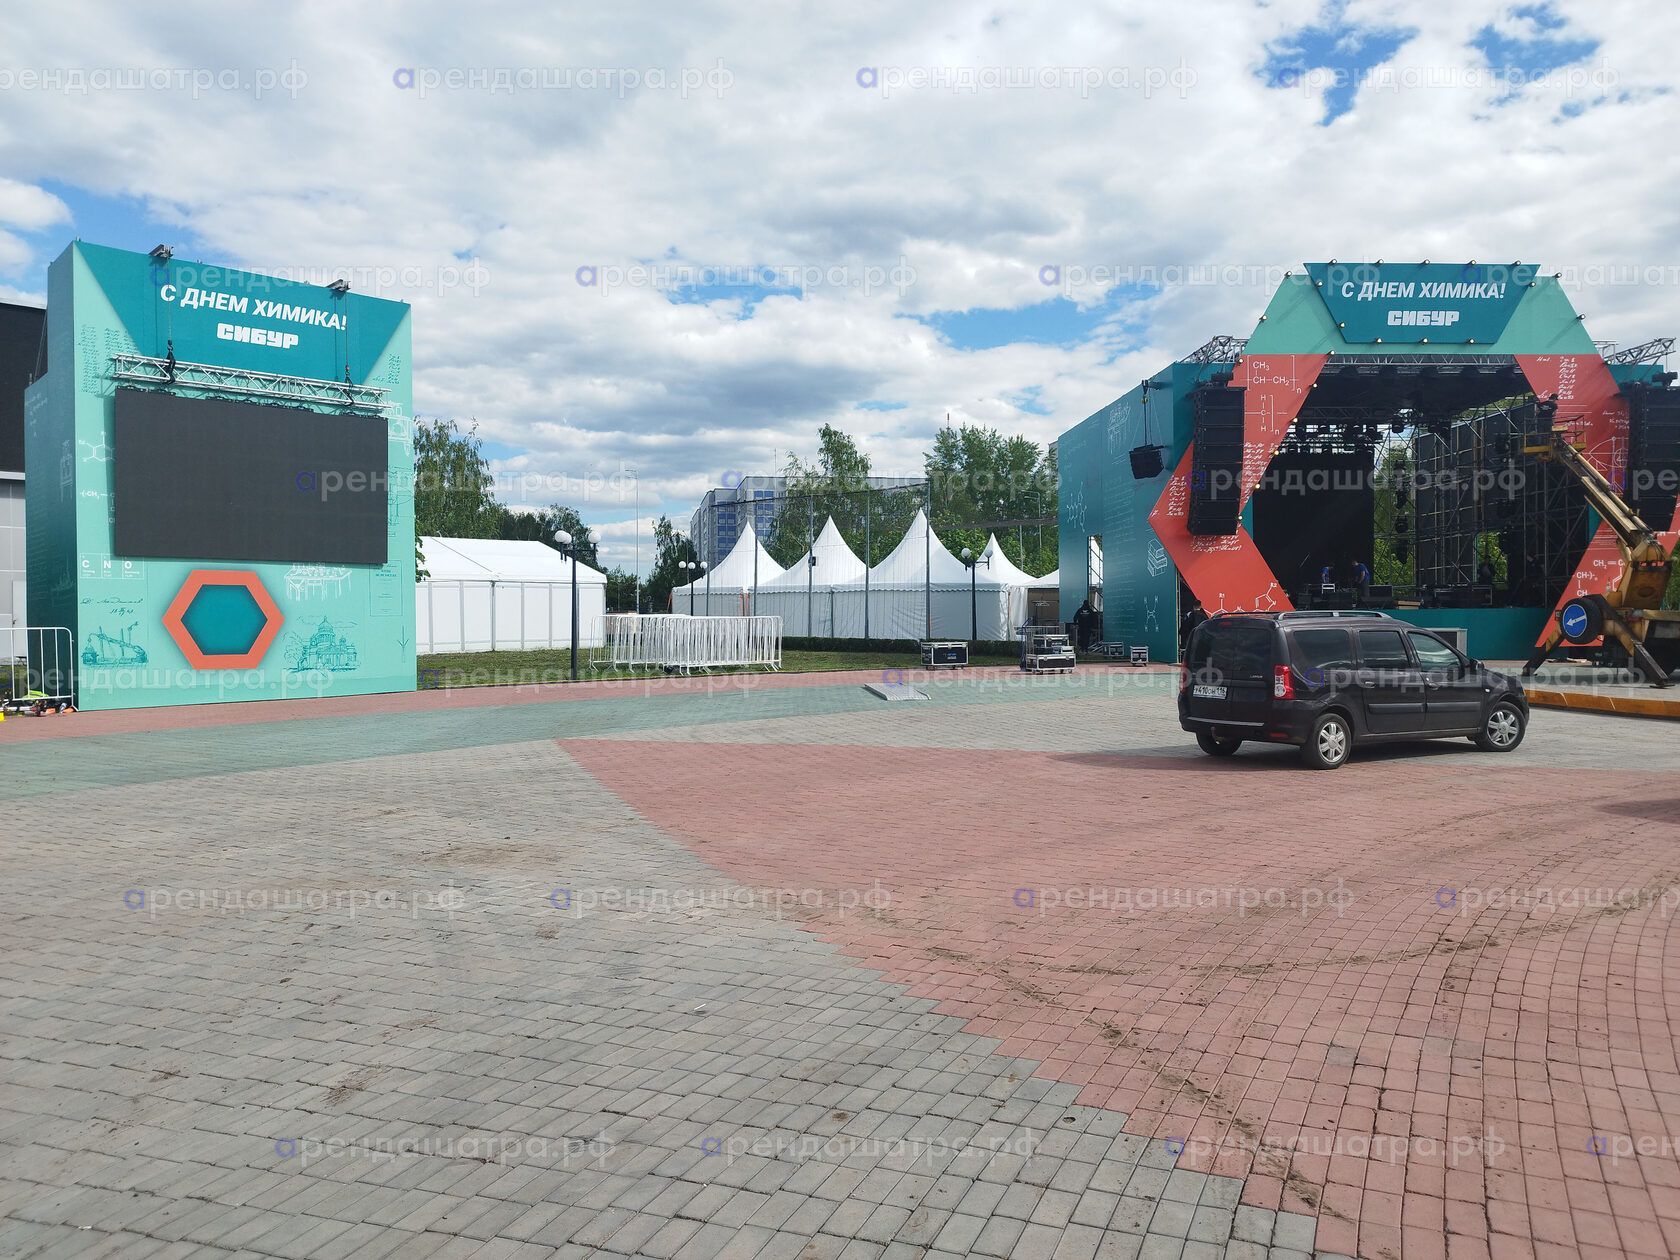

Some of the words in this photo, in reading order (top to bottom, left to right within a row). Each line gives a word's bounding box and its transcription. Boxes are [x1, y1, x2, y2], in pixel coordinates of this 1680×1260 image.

[1341, 282, 1355, 298] С
[1357, 282, 1416, 302] ДНЕМ
[1418, 282, 1507, 300] ХИМИКА!
[160, 284, 177, 302] С
[180, 287, 249, 314] ДНЕМ
[252, 299, 348, 331] ХИМИКА!
[1387, 310, 1461, 327] СИБУР
[216, 323, 299, 349] СИБУР
